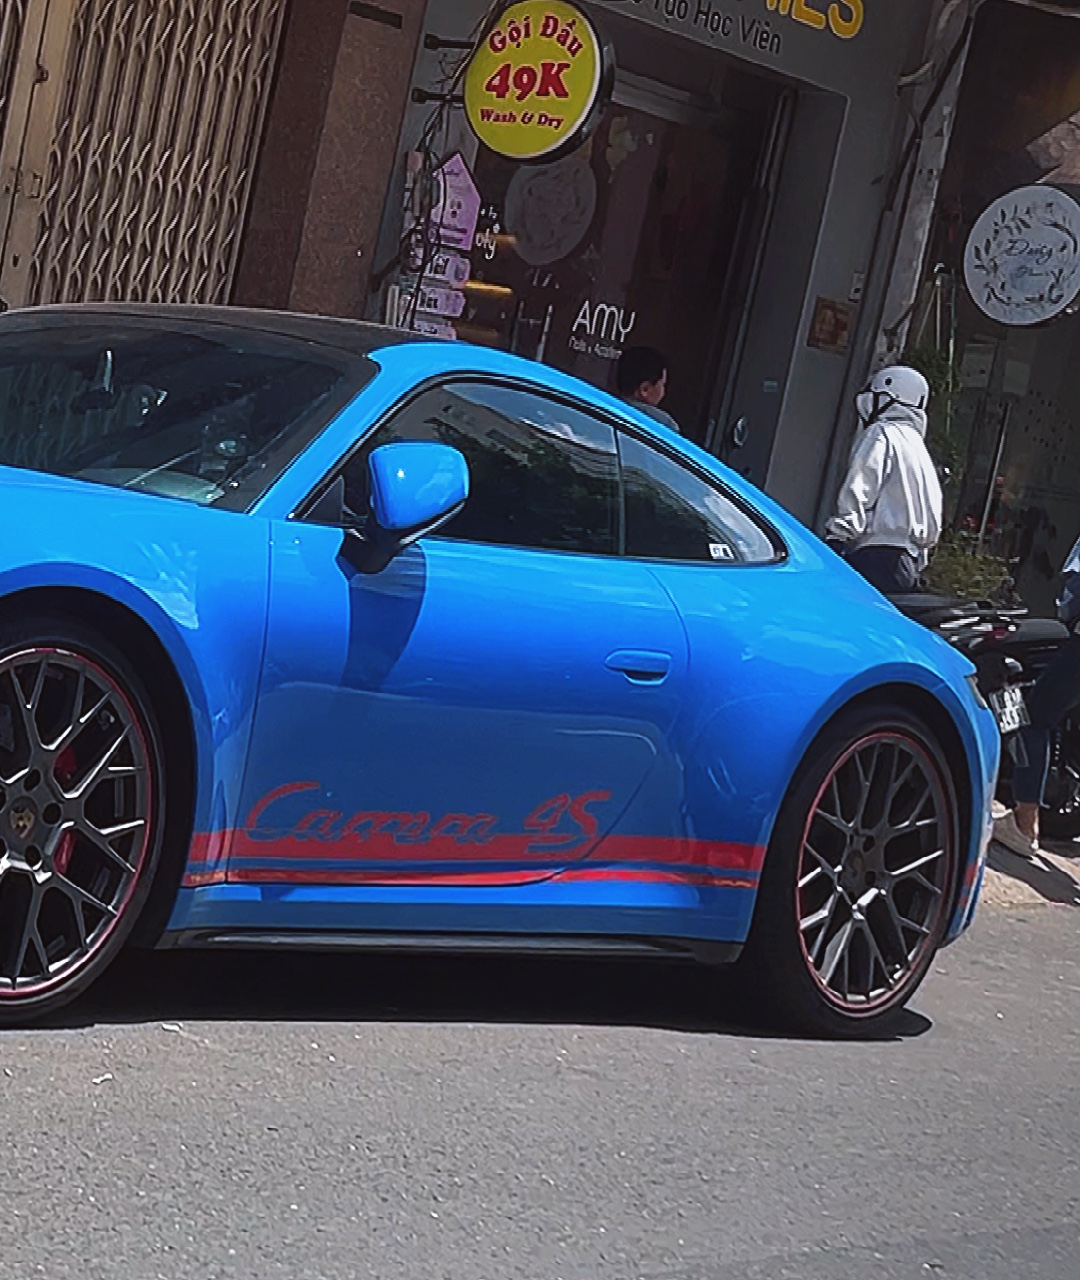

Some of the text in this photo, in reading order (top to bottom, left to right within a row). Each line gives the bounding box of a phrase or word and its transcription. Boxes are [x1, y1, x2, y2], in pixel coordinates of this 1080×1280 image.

[488, 14, 532, 54] Gội
[484, 61, 571, 102] 49K
[480, 107, 564, 130] Wash & Dry
